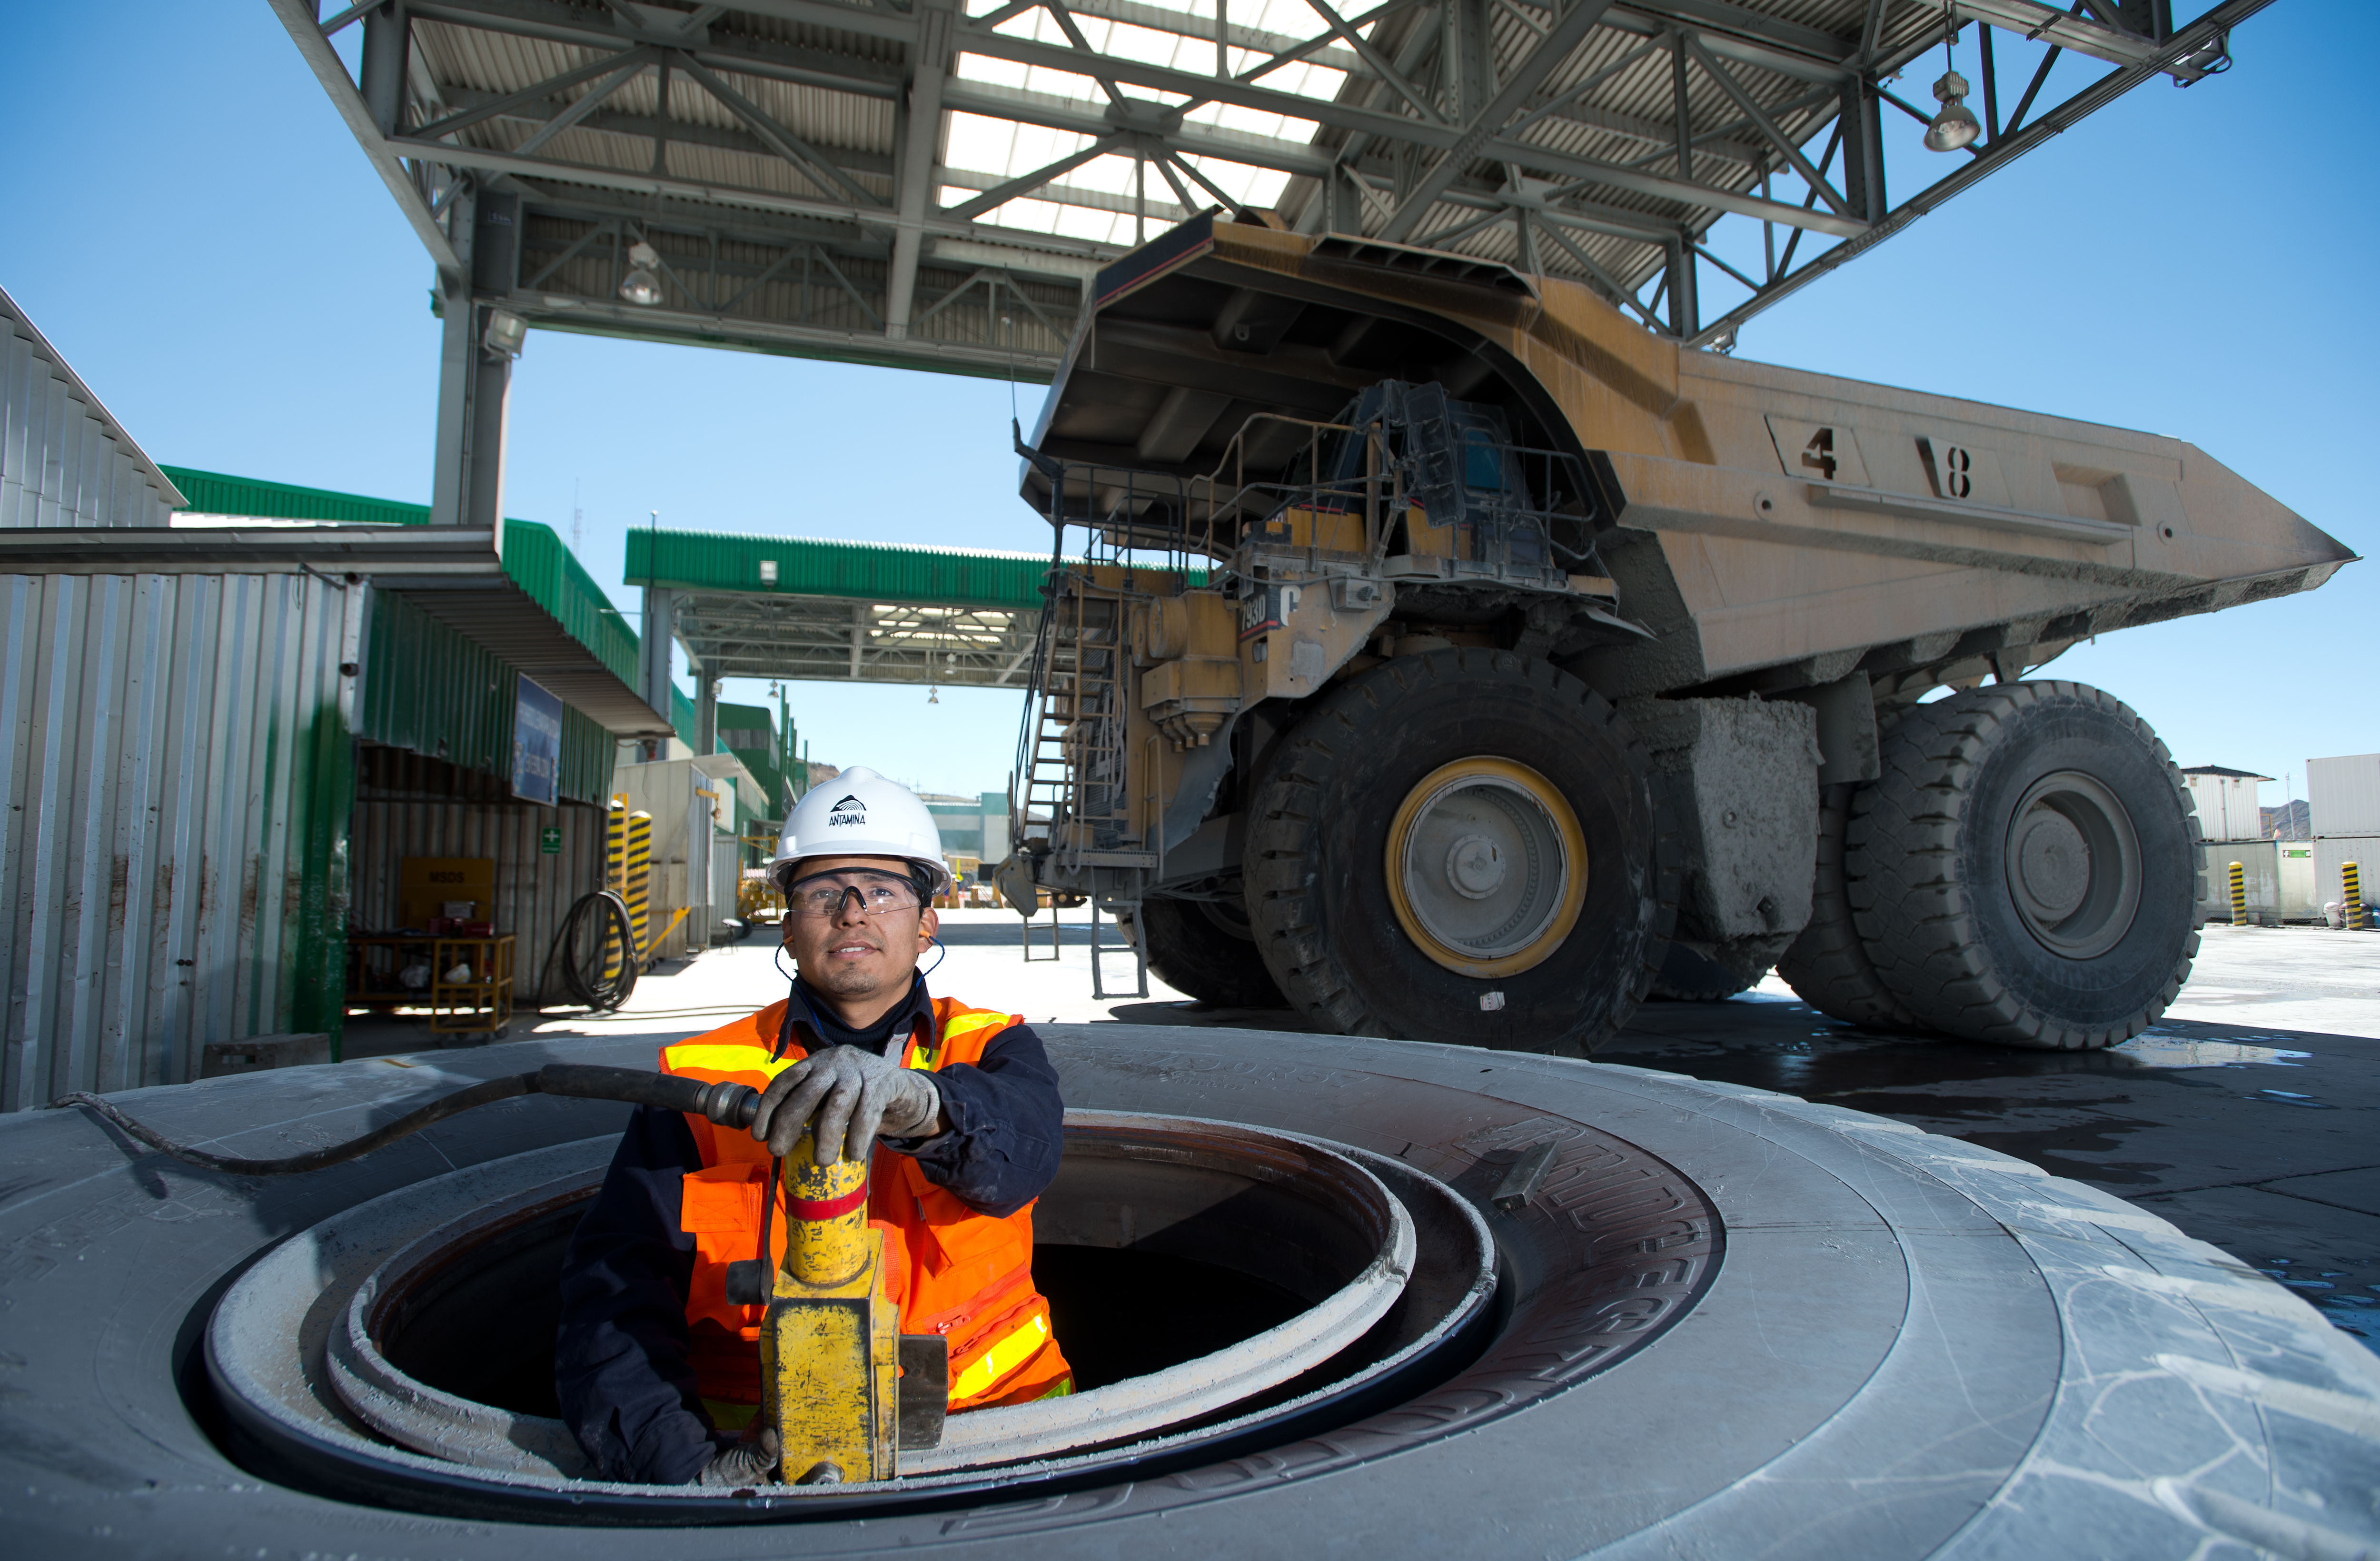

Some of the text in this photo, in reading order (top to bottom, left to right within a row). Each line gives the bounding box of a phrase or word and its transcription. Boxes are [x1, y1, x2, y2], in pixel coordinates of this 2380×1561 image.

[1802, 427, 1970, 498] 4 8
[829, 812, 866, 827] ANTAMINA
[429, 872, 465, 883] MSDS
